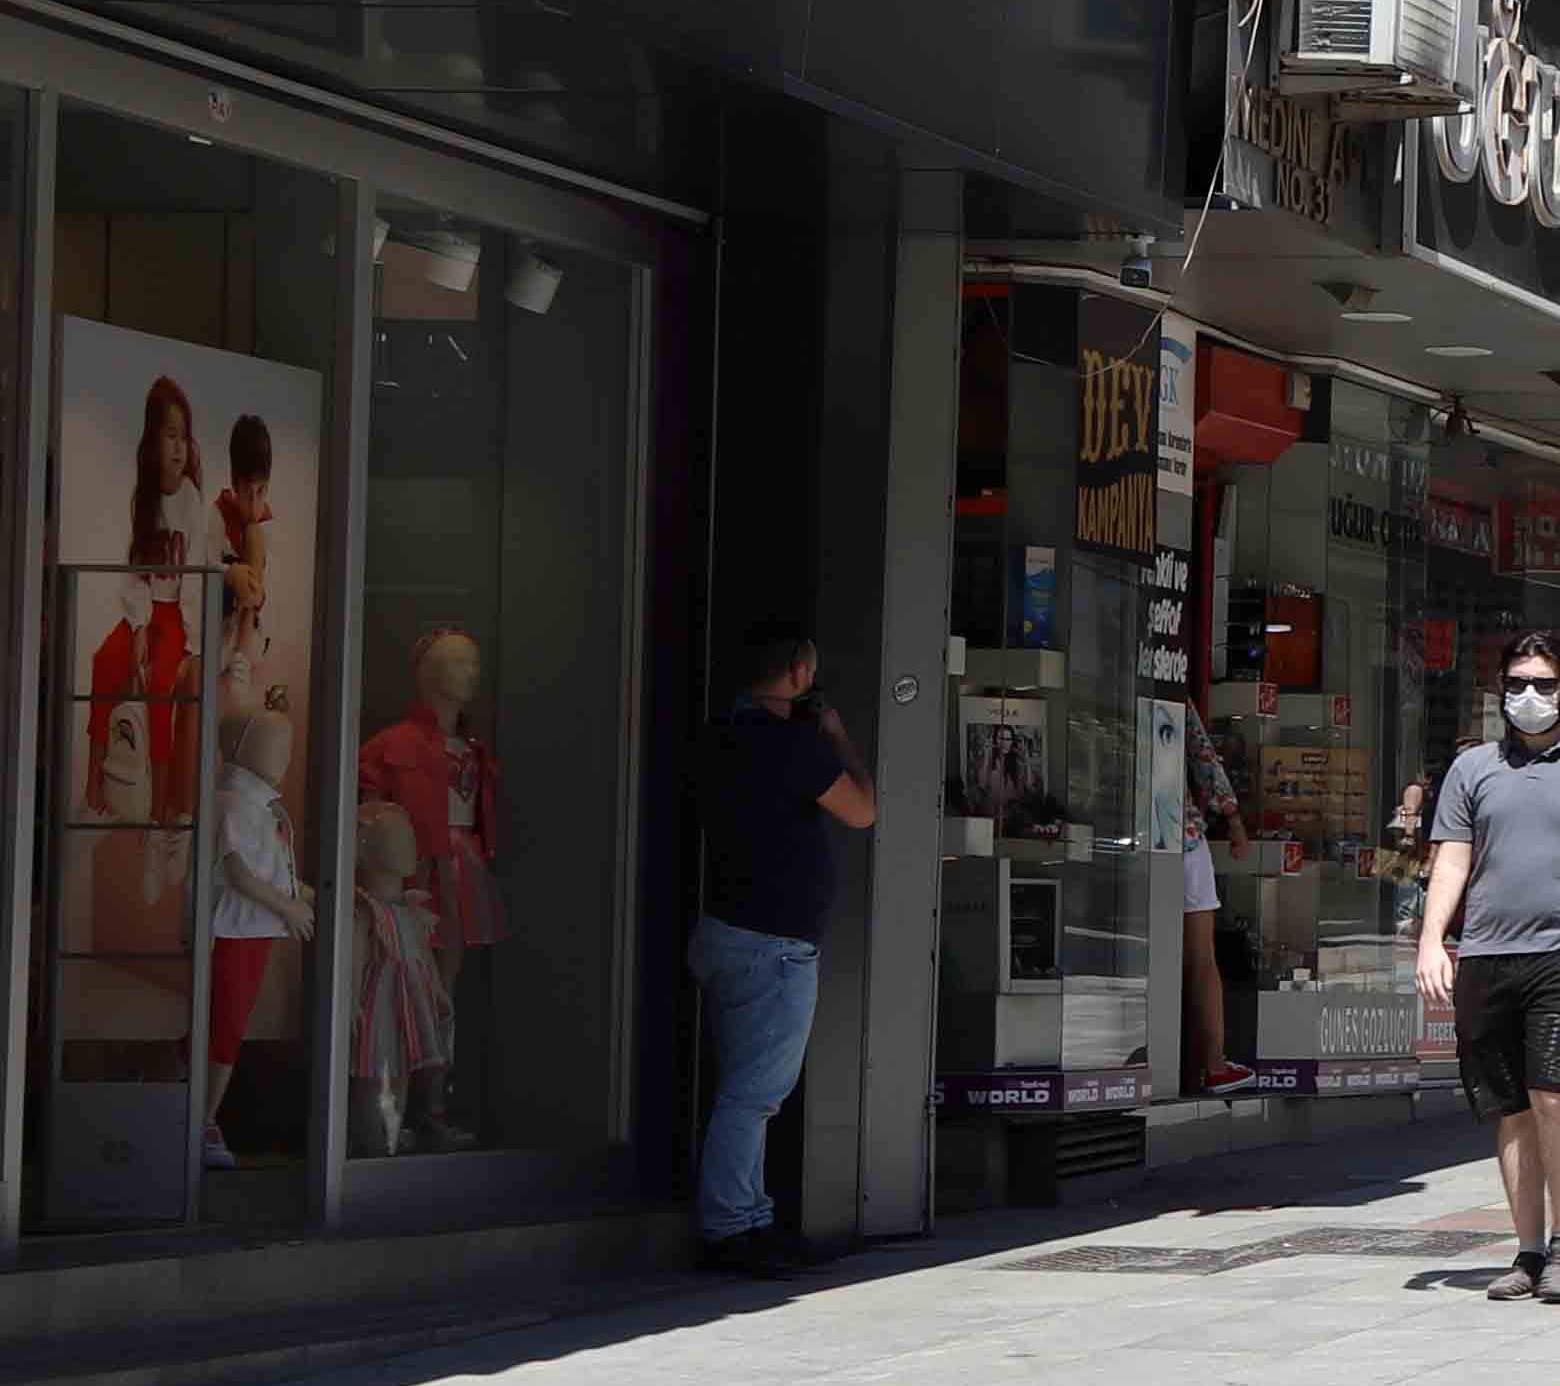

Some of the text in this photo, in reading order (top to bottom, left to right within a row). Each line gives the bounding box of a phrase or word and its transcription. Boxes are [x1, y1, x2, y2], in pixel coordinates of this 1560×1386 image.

[1078, 473, 1157, 555] KAMPANYA
[1258, 1074, 1297, 1089] RLD
[967, 1089, 1050, 1104] WORLD
